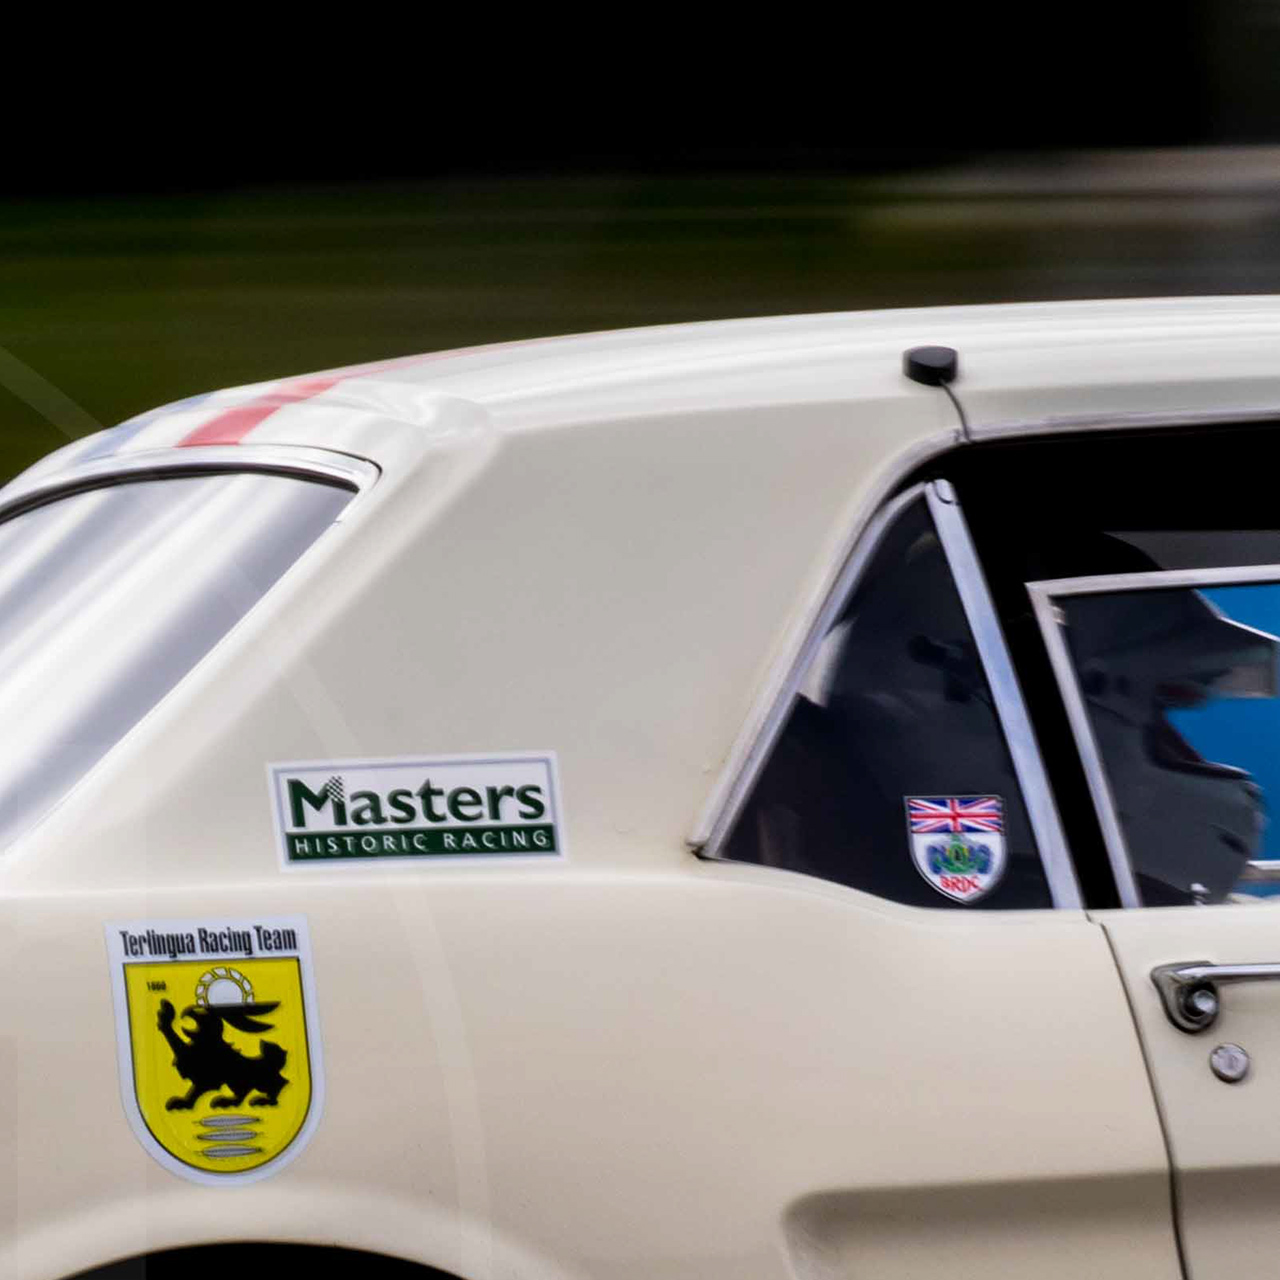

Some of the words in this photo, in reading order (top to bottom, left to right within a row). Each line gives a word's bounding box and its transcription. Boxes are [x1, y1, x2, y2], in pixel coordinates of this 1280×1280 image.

[286, 775, 546, 828] Masters
[294, 833, 429, 856] HISTORIC
[443, 829, 551, 849] RACING
[119, 929, 195, 958] Terlingua
[197, 926, 254, 955] Racing
[253, 925, 298, 952] Team
